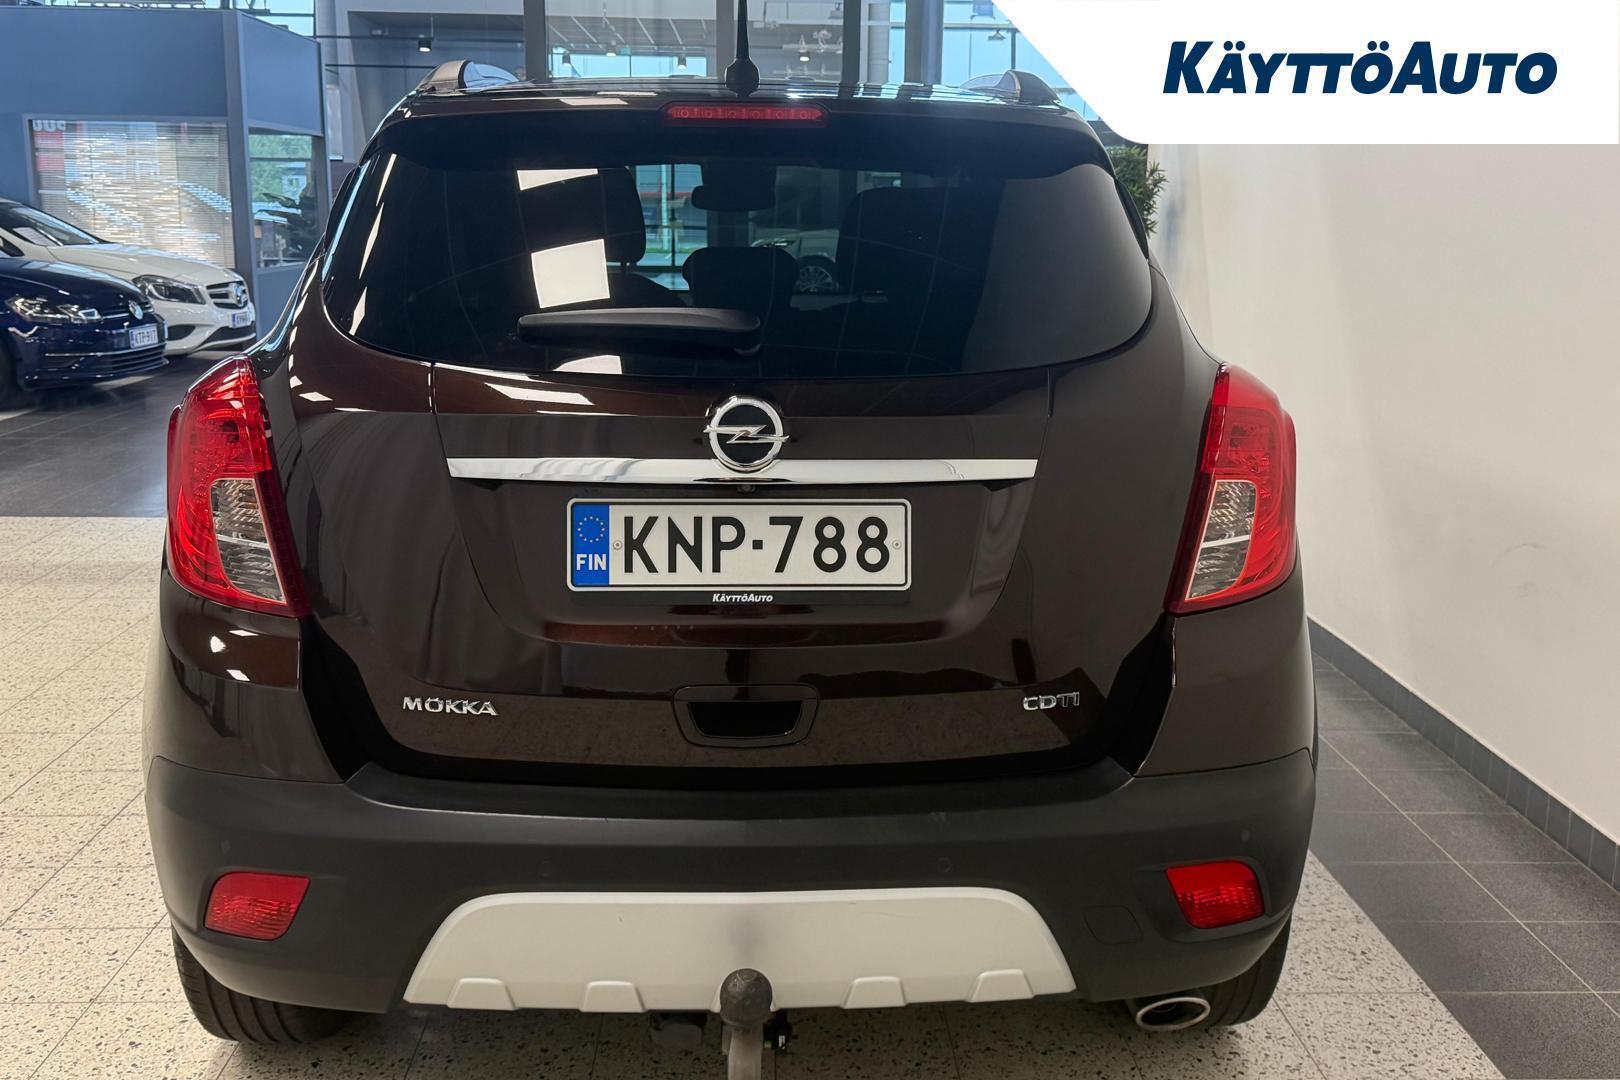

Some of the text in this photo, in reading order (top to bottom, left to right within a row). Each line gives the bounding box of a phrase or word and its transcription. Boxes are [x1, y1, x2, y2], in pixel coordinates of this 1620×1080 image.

[623, 516, 890, 573] KNP-788
[576, 553, 607, 571] FIN
[402, 696, 498, 716] MOKKA
[1023, 691, 1080, 711] CDTI
